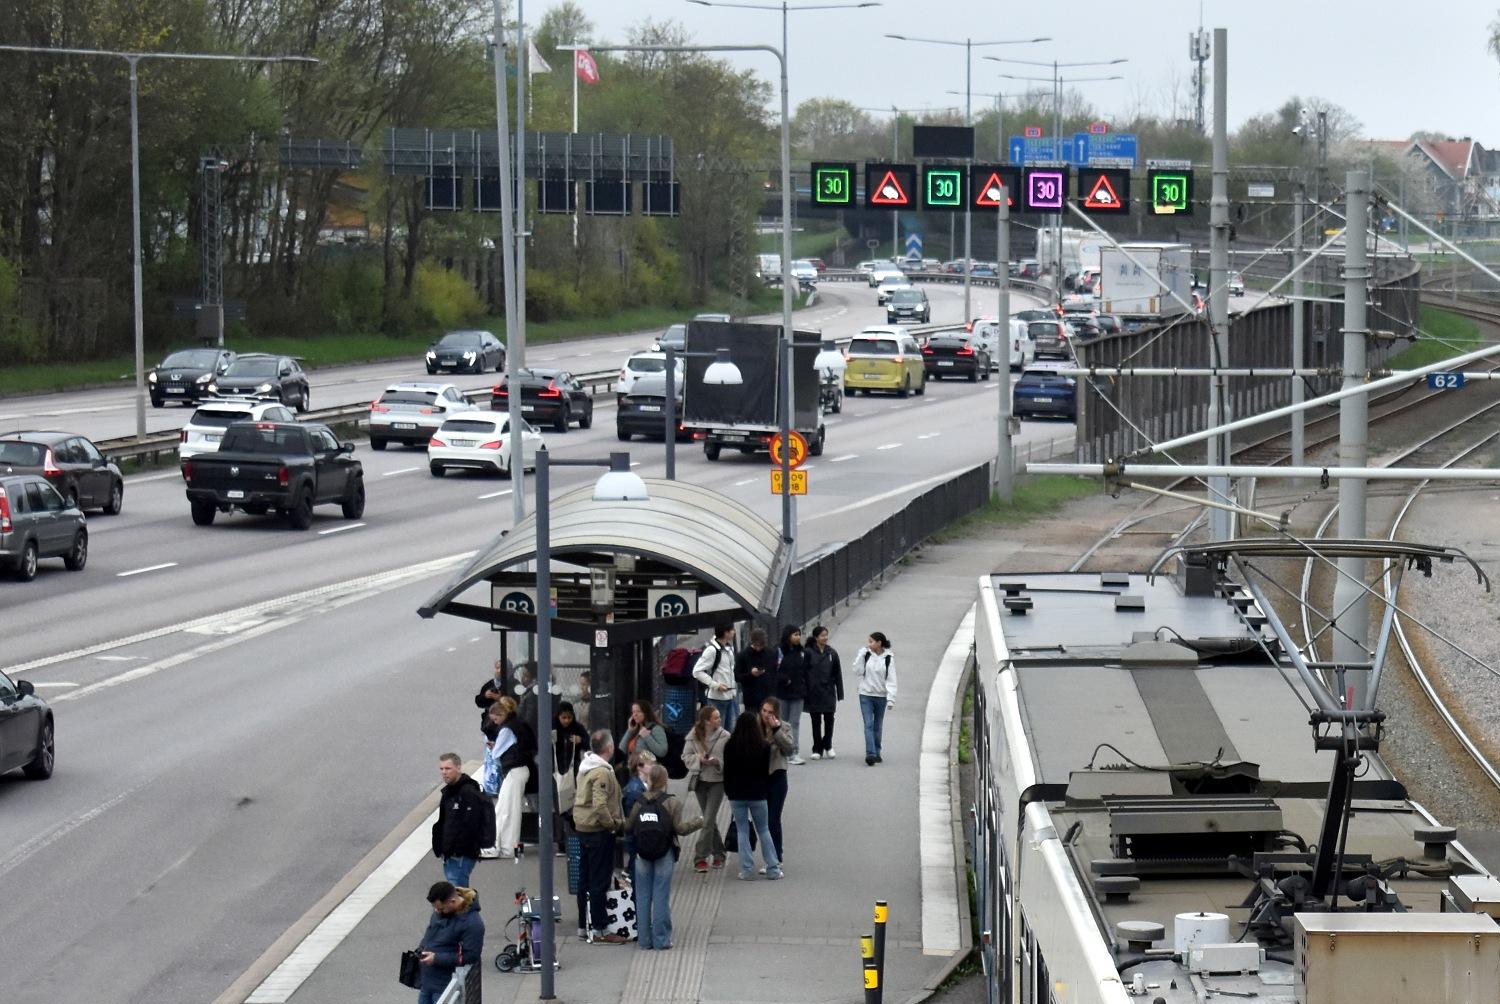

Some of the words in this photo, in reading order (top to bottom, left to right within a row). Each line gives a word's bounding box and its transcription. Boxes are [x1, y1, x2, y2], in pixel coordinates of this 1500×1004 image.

[824, 178, 842, 195] 30
[935, 179, 953, 197] 30
[1036, 181, 1055, 199] 30
[1161, 183, 1179, 202] 30
[1435, 375, 1458, 388] 62
[661, 602, 684, 617] B2
